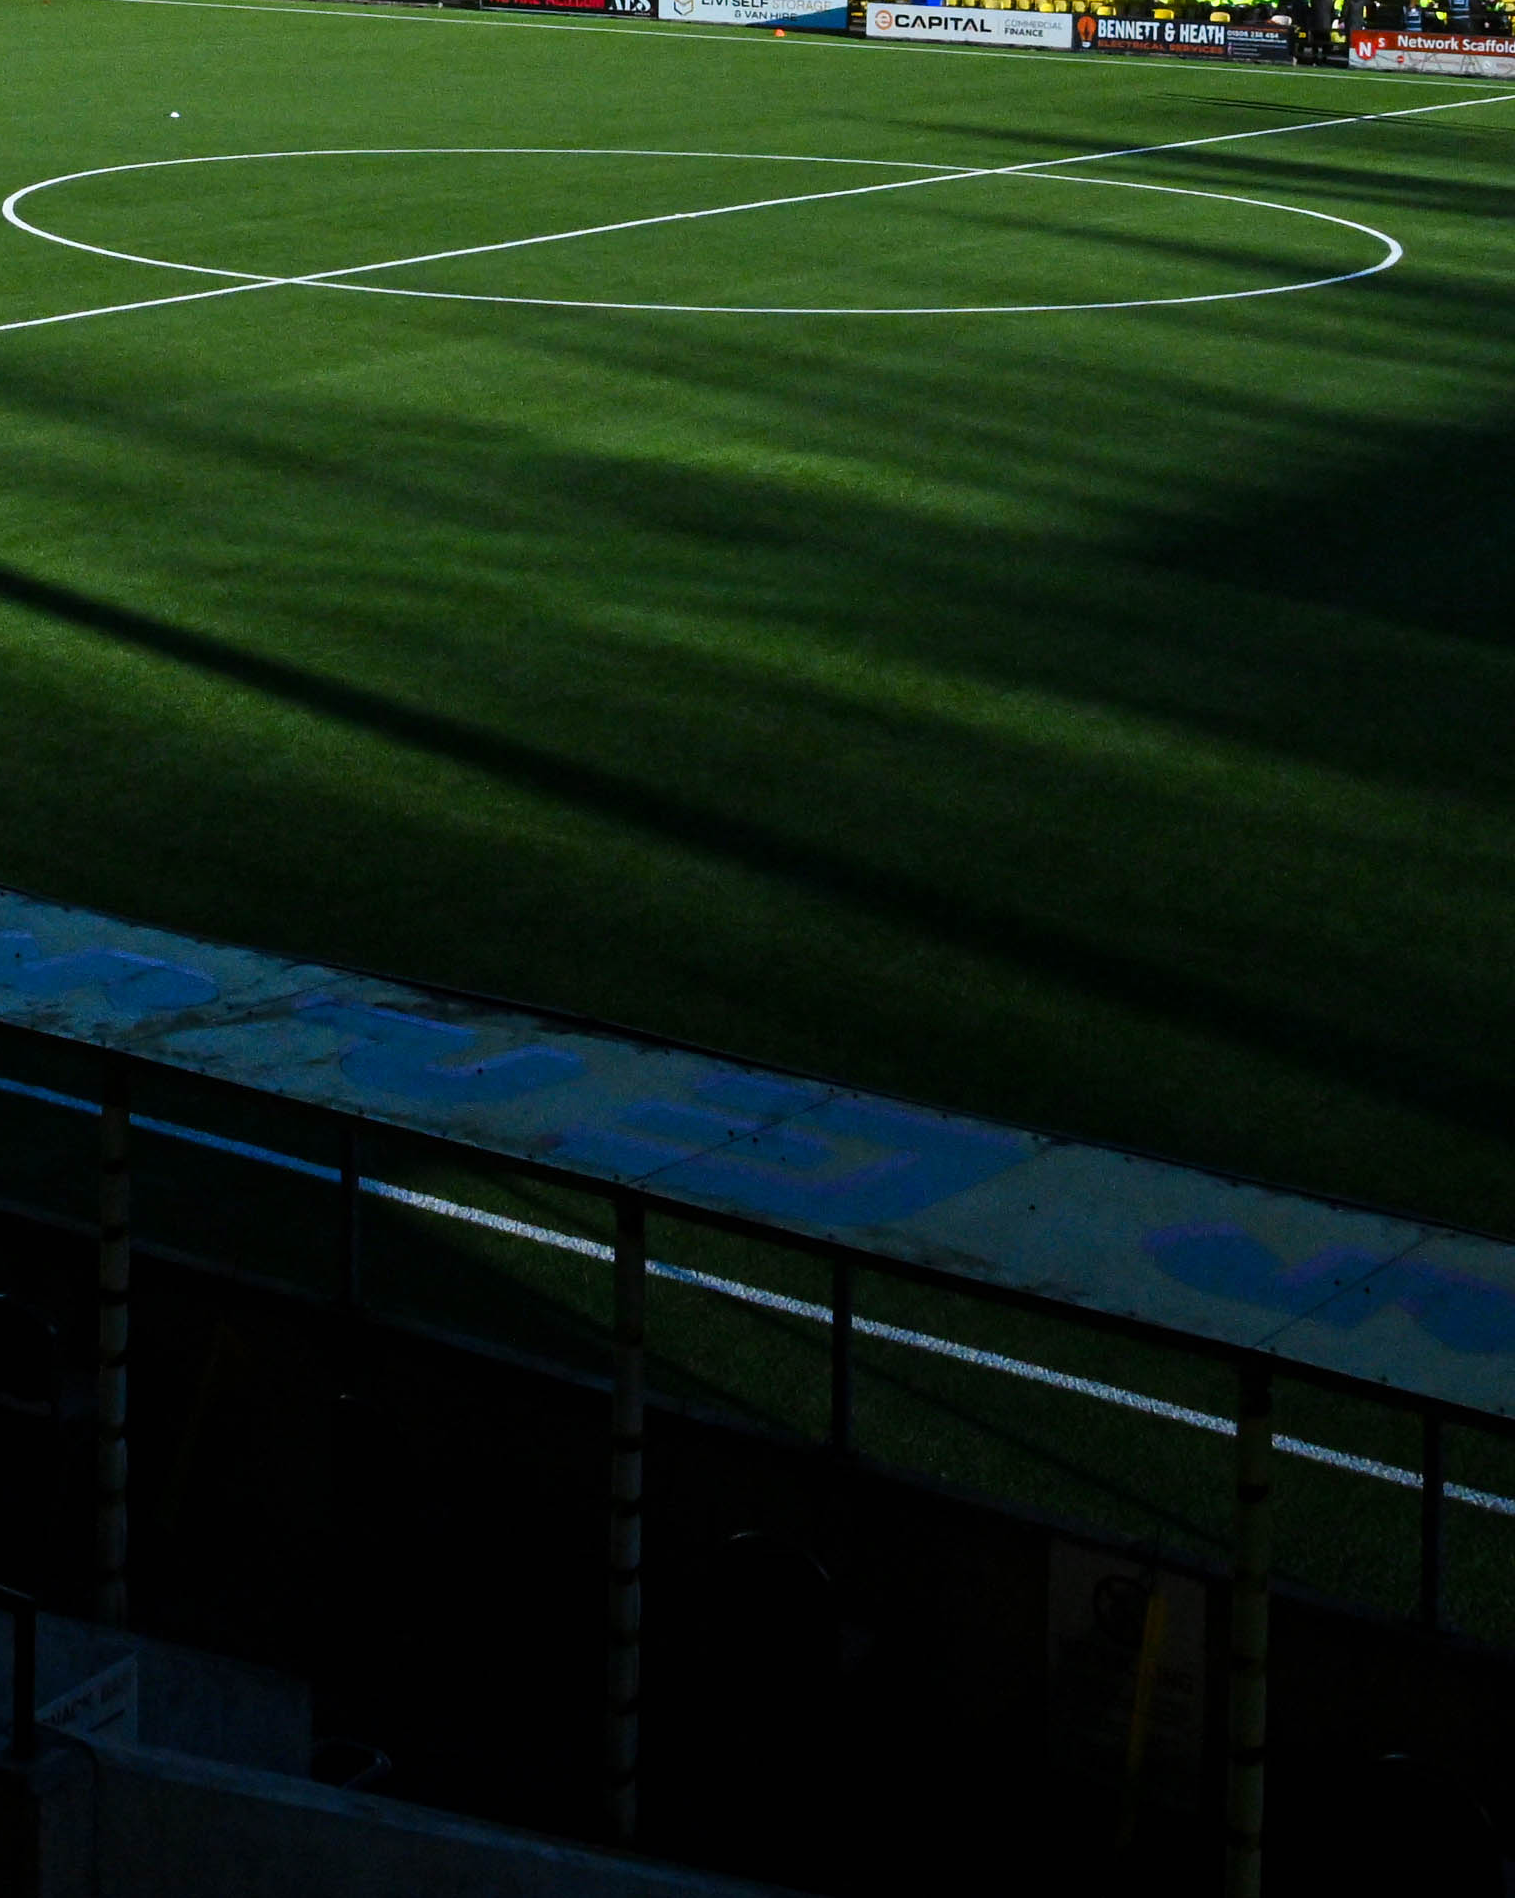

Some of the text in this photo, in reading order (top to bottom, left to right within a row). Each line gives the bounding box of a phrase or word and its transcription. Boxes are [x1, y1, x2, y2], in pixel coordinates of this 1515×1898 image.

[744, 10, 768, 20] VAN
[770, 12, 798, 22] HIRE
[1004, 28, 1044, 38] FINANCE
[1097, 18, 1160, 40] BENNETT
[1164, 21, 1175, 39] &
[1179, 23, 1225, 45] HEATH
[1397, 34, 1458, 50] Network
